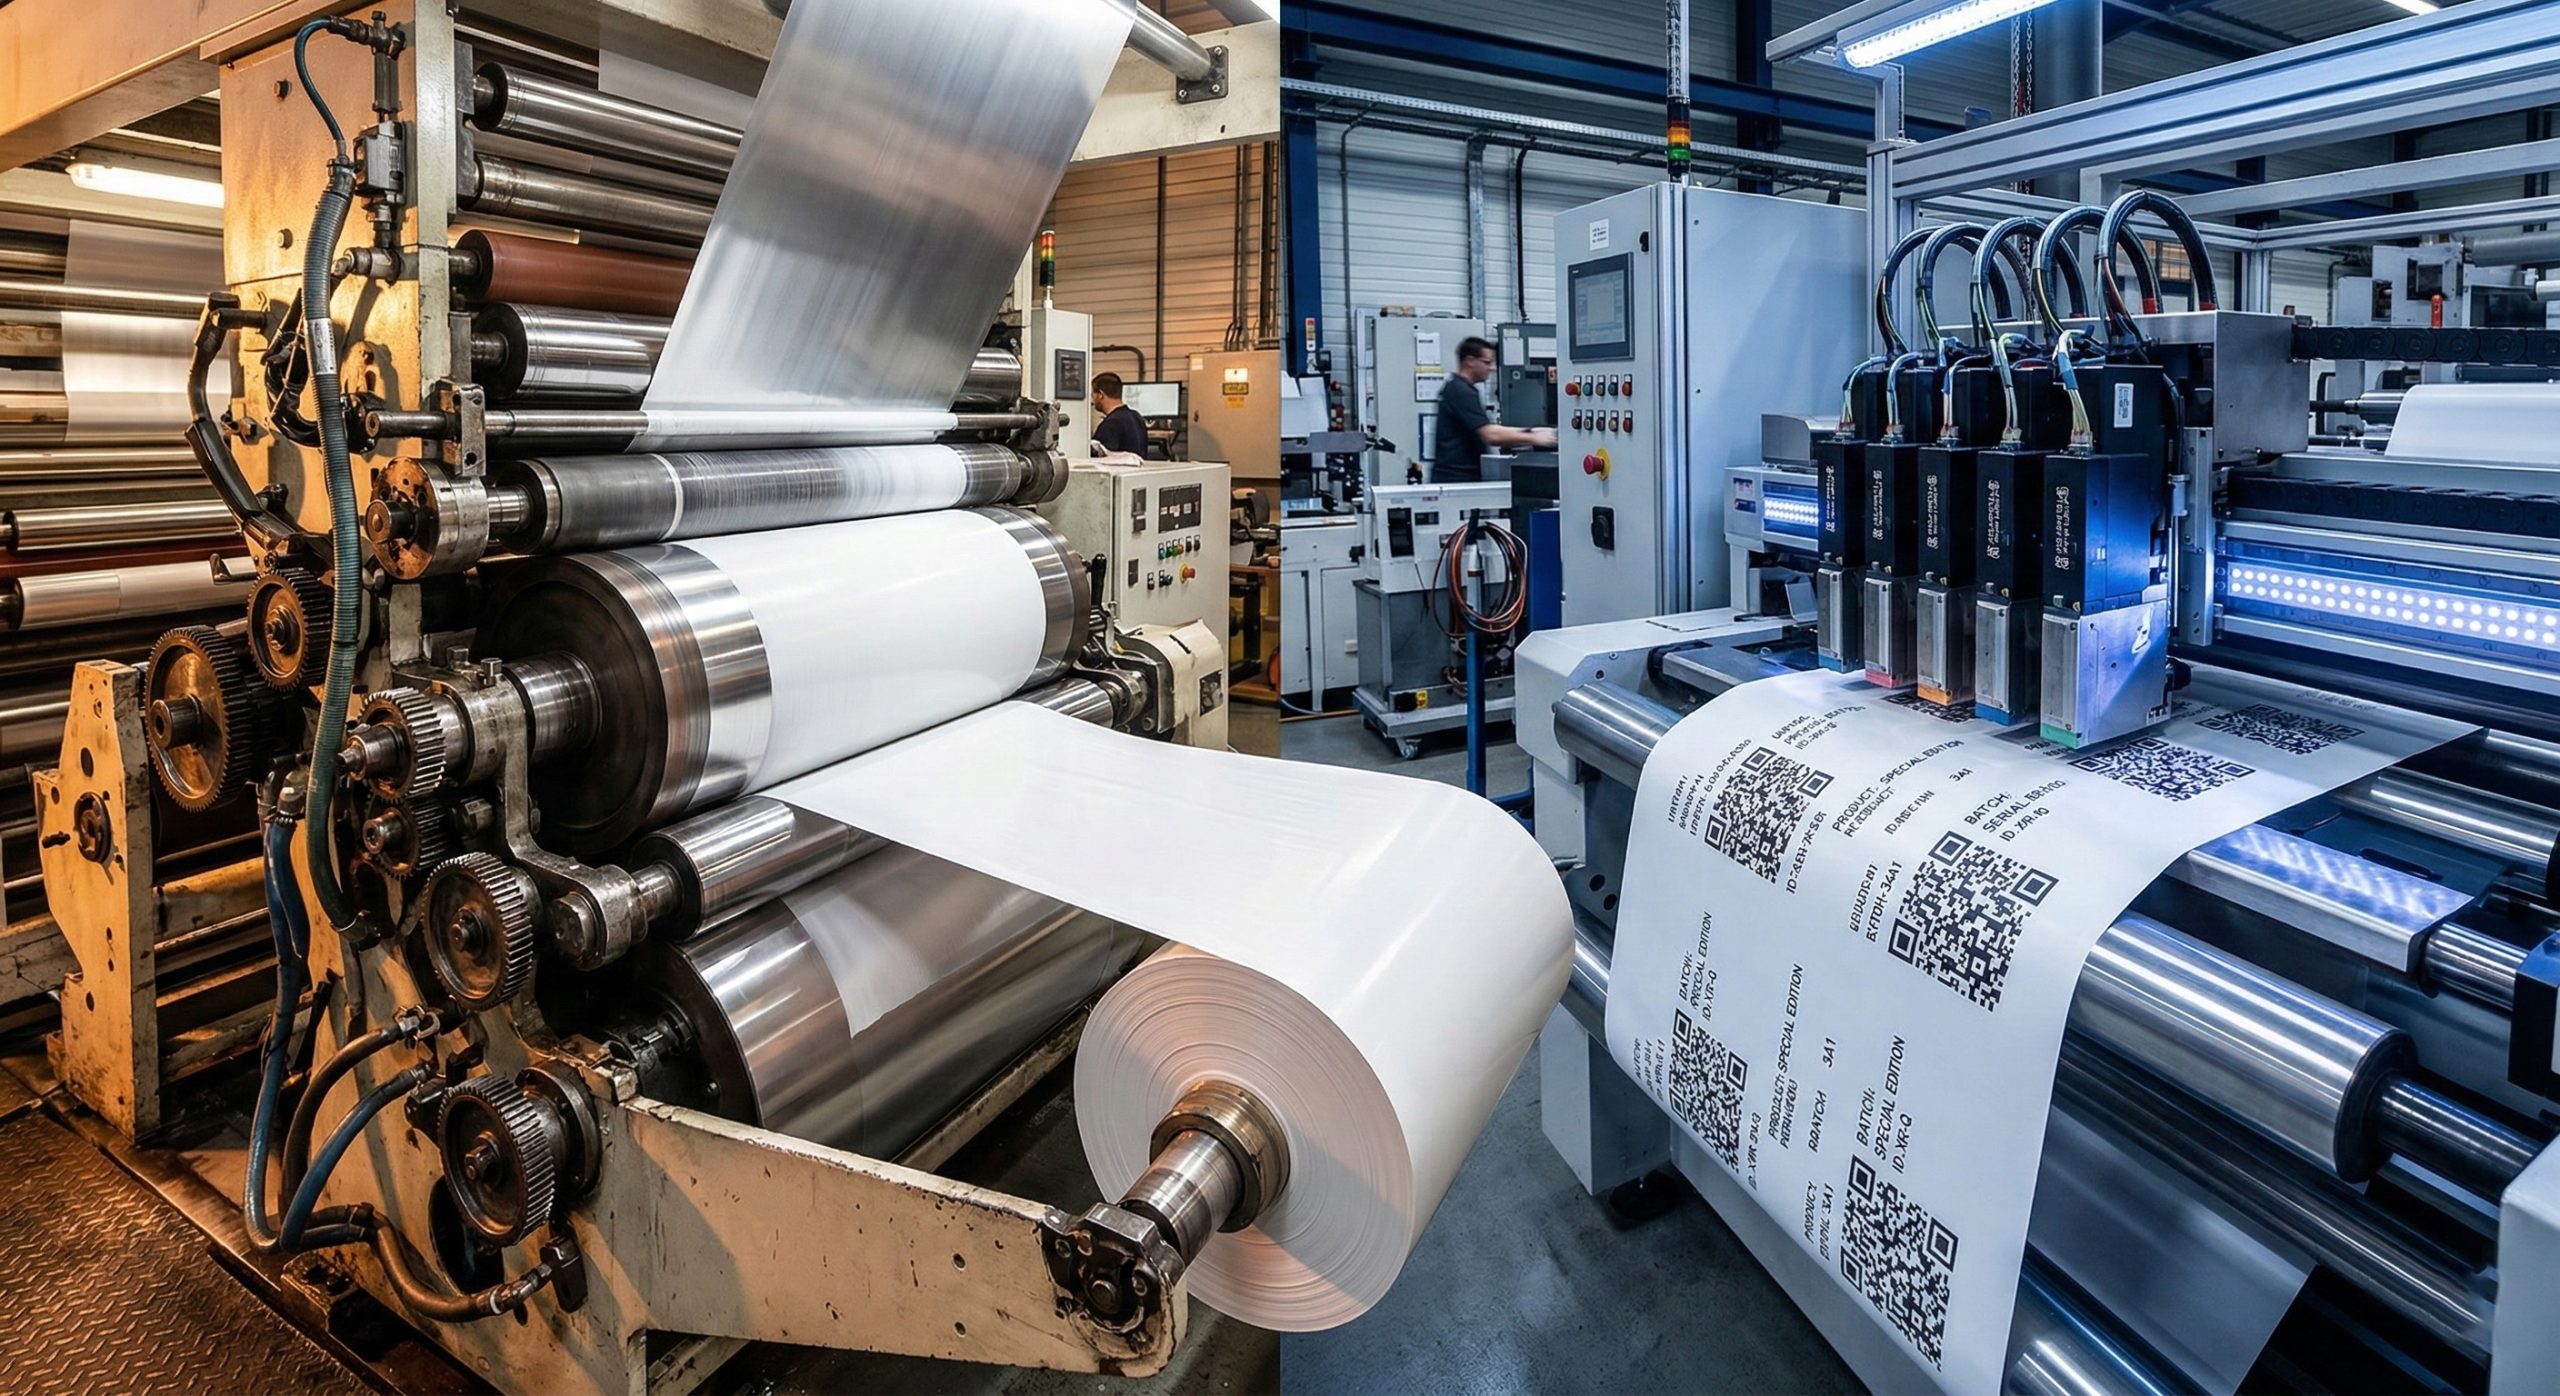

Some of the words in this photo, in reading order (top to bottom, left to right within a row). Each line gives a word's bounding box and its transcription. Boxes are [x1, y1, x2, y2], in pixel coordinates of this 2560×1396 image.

[1777, 1019, 1795, 1074] SPECIAL
[1786, 963, 1803, 1017] EDITION
[1874, 1098, 1896, 1161] SPECIAL
[1885, 1035, 1906, 1096] EDITION
